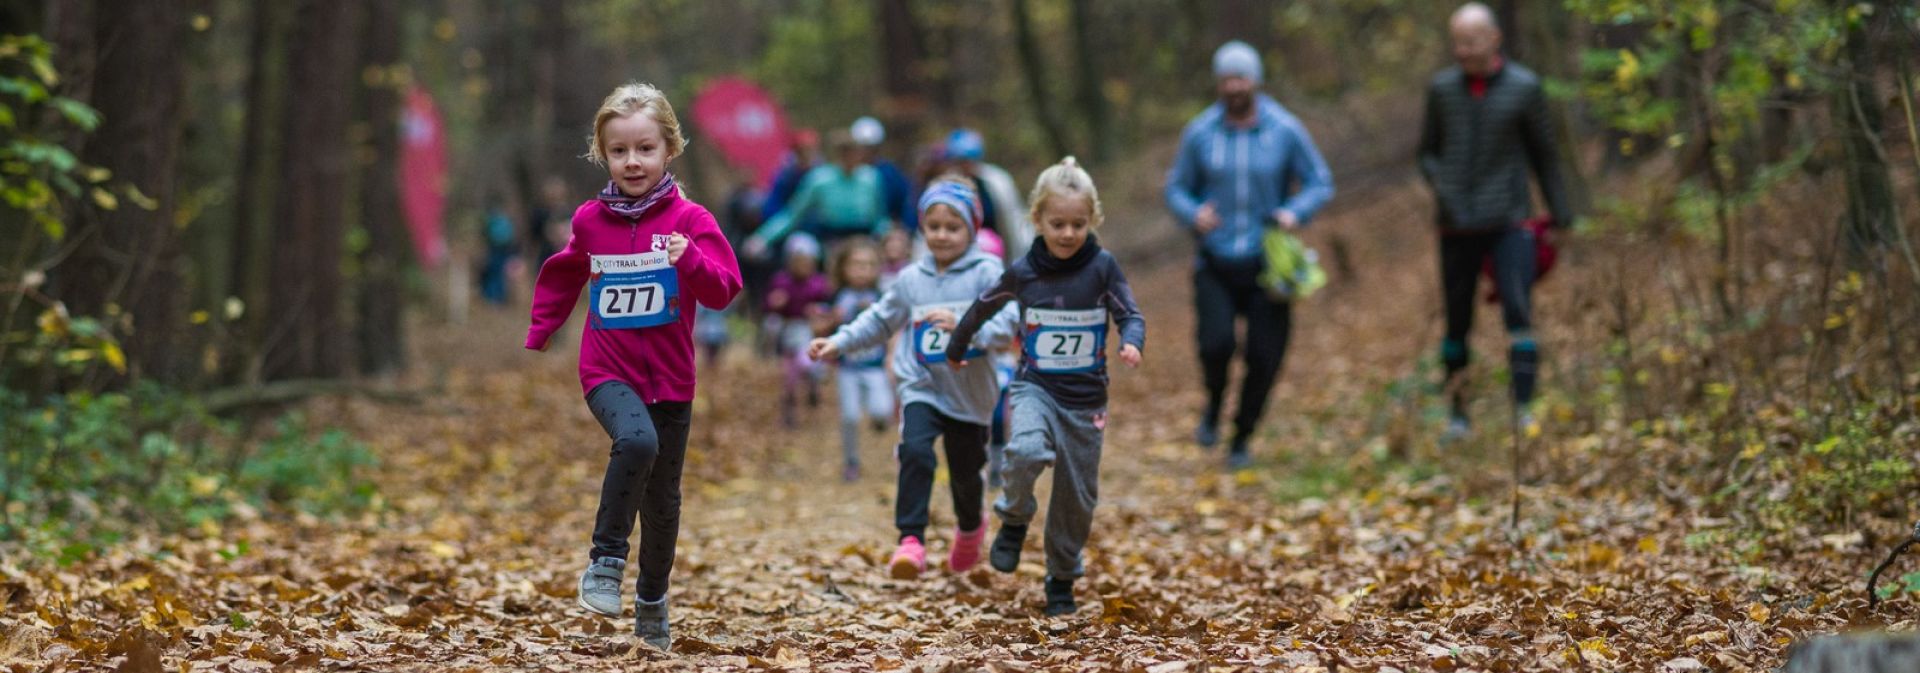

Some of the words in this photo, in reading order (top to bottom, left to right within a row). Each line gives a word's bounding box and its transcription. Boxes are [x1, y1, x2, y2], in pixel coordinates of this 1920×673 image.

[641, 256, 665, 266] Junior
[605, 286, 655, 314] 277
[1051, 334, 1083, 355] 27
